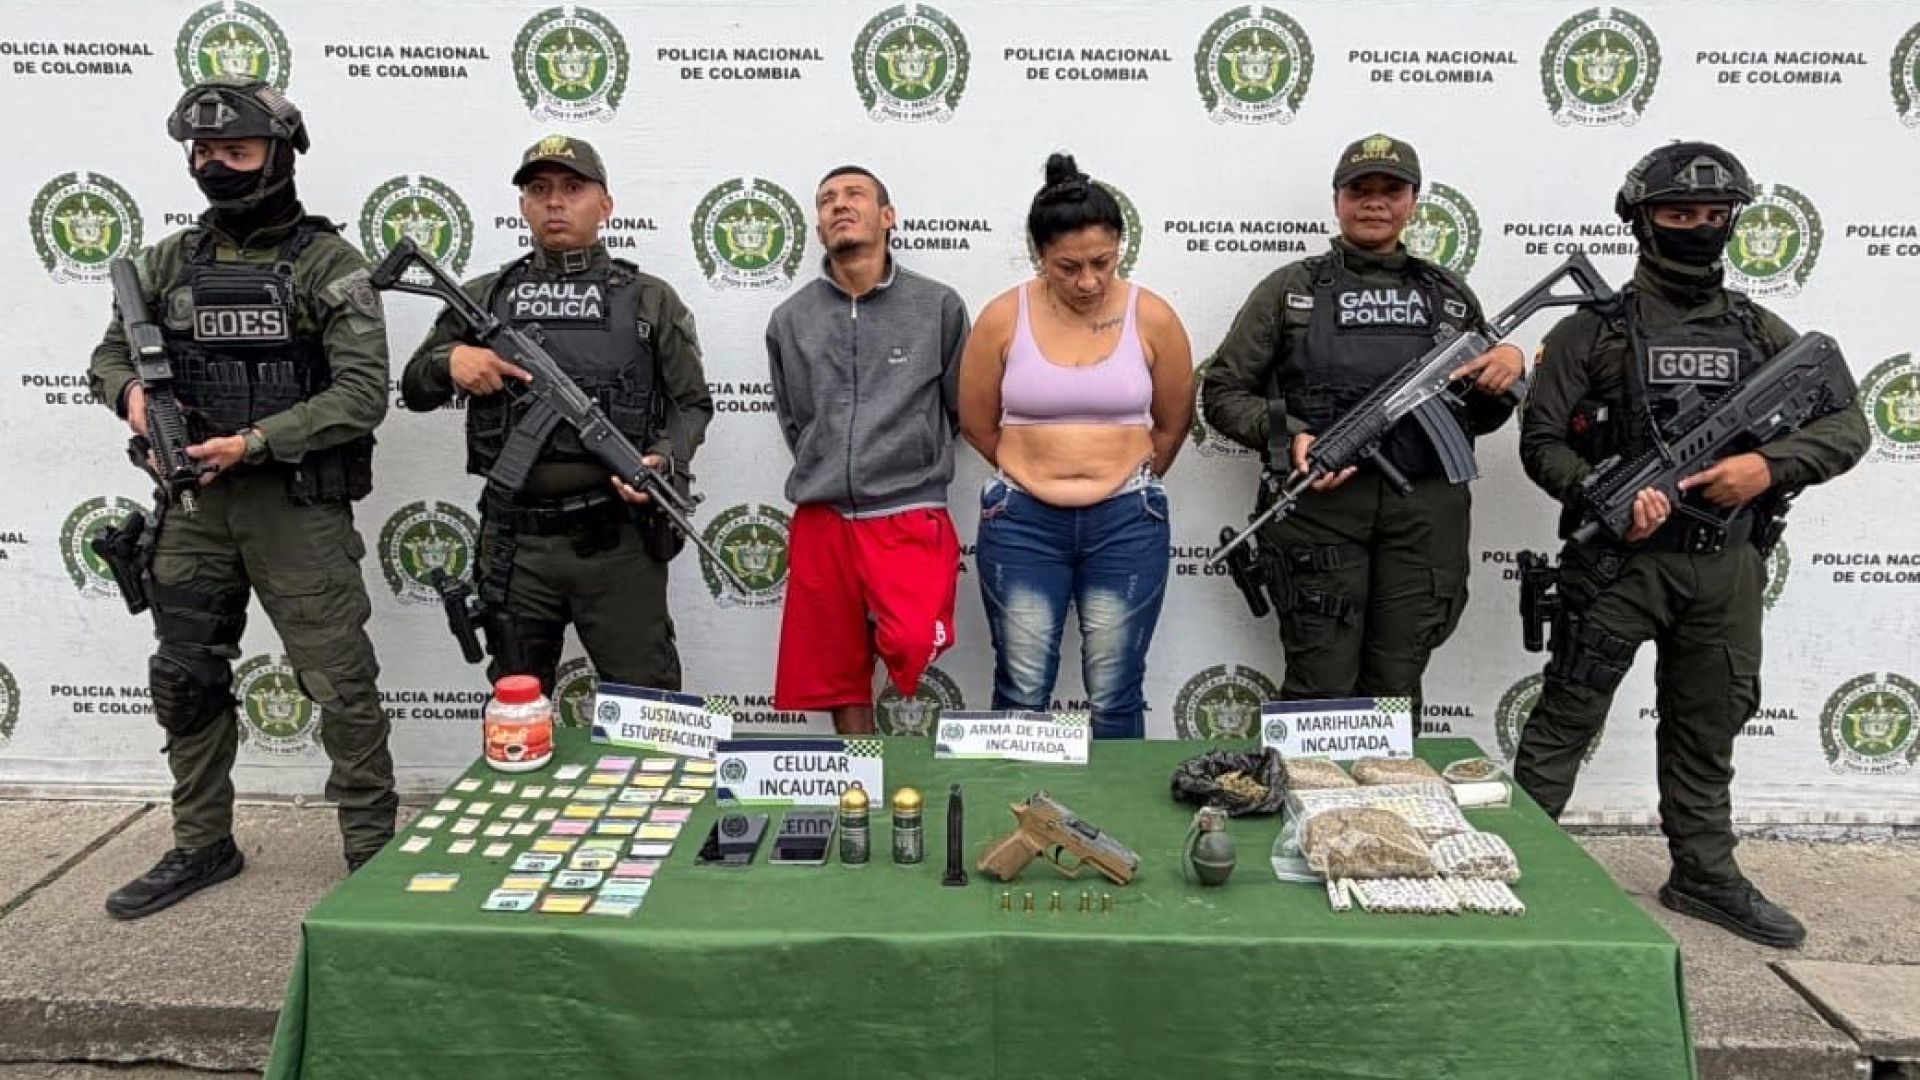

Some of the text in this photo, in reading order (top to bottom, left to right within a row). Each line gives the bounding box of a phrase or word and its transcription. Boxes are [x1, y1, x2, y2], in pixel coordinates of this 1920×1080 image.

[0, 42, 153, 55] OLICIA NACIONAL
[325, 46, 489, 59] POLICIA NACIONAL
[658, 49, 823, 60] POLICIA NACIONAL
[1004, 49, 1170, 61] POLICIA NACIONAL
[1349, 51, 1516, 64] POLICIA NACIONAL
[1697, 52, 1867, 64] POLICIA NACIONAL
[14, 62, 131, 74] DE COLOMBIA
[349, 64, 467, 77] DE COLOMBIA
[681, 68, 800, 79] DE COLOMBIA
[1027, 68, 1148, 80] DE COLOMBIA
[1371, 70, 1493, 83] DE COLOMBIA
[1719, 71, 1841, 83] DE COLOMBIA
[1351, 150, 1400, 163] GAULA
[606, 218, 657, 230] IONAL
[904, 219, 991, 231] NACIONAL
[1165, 221, 1329, 234] POLICIA NACIONAL
[1504, 224, 1633, 236] POLICIA NACIO
[1846, 226, 1916, 237] POLICIA
[891, 238, 970, 250] OLOMBIA
[1187, 240, 1305, 252] DE COLOMBIA
[1526, 243, 1547, 254] DE
[1868, 245, 1890, 256] DE
[518, 282, 601, 301] GAULA
[1339, 288, 1425, 309] GAULA
[199, 310, 282, 335] GOES
[1658, 352, 1731, 377] GOES
[22, 375, 88, 387] POLICIA
[46, 393, 66, 404] DE
[716, 401, 776, 412] COLOM
[1813, 554, 1880, 565] POLICIA
[1176, 564, 1197, 575] DE
[1833, 571, 1920, 583] DE COLOM
[51, 686, 115, 696] POLICIA
[74, 703, 153, 714] DE COLOM
[386, 708, 480, 719] DE COLOMB
[1423, 704, 1474, 717] IONAL
[640, 704, 712, 729] SUSTANCIAS
[732, 711, 807, 724] OLOMBIA
[1297, 714, 1394, 732] MARIHUANA
[621, 722, 716, 749] ESTUPEFACIENT
[970, 725, 1083, 739] ARMA DE FUEGO
[986, 740, 1066, 754] INCAUTADA
[1301, 735, 1390, 753] INCAUTADA
[774, 755, 849, 773] CELULAR
